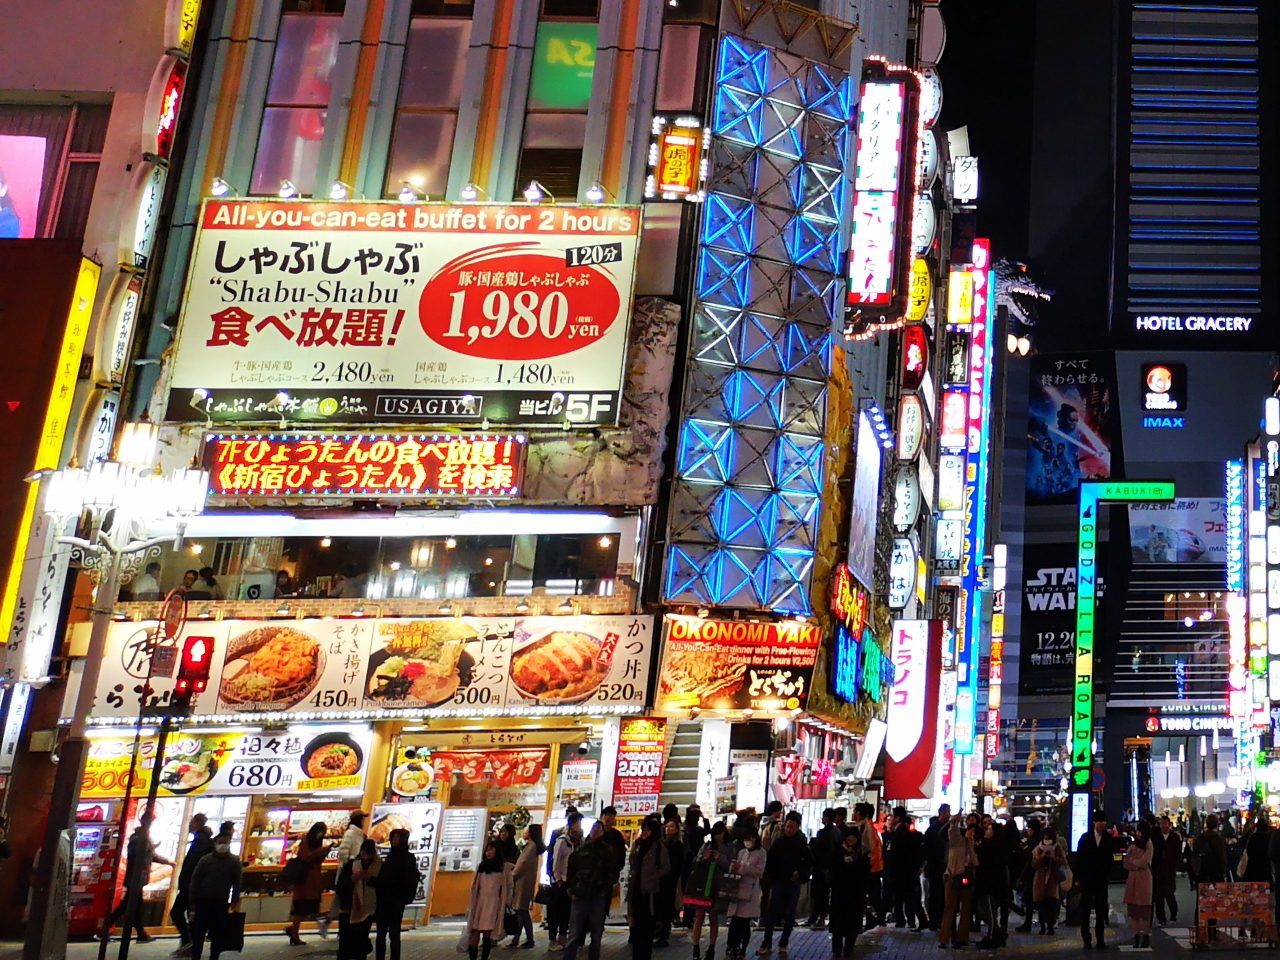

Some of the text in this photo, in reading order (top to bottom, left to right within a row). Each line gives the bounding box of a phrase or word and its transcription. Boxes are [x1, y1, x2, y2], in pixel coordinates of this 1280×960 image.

[213, 206, 632, 231] All-you-can-eat buffet for 2 hours
[214, 240, 425, 275] しゃぶしゃぶ
[568, 246, 619, 266] 120分
[442, 290, 599, 345] 1,980 yen
[1136, 316, 1252, 331] HOTEL GRACERY
[311, 360, 371, 384] 2,480
[370, 373, 395, 385] yen
[494, 362, 552, 386] 1,480
[551, 374, 575, 386] yen
[1054, 359, 1089, 370] すべて
[384, 398, 475, 414] USAGIYA
[565, 394, 613, 421] 5F
[1143, 417, 1183, 428] IMAX
[1027, 568, 1103, 586] STA
[1027, 591, 1103, 611] WA
[329, 624, 346, 656] そば
[672, 620, 820, 645] OKONOMI YAKI
[1075, 523, 1094, 740] GODZILLA ROAD
[622, 618, 647, 681] かつ丼
[753, 656, 763, 665] for
[763, 657, 770, 665] 2
[770, 657, 791, 666] hours
[310, 689, 358, 708] 450円
[454, 686, 501, 706] 500円
[597, 682, 644, 702] 520円
[1160, 718, 1234, 731] TOHO CINEMA
[228, 765, 293, 788] 680円
